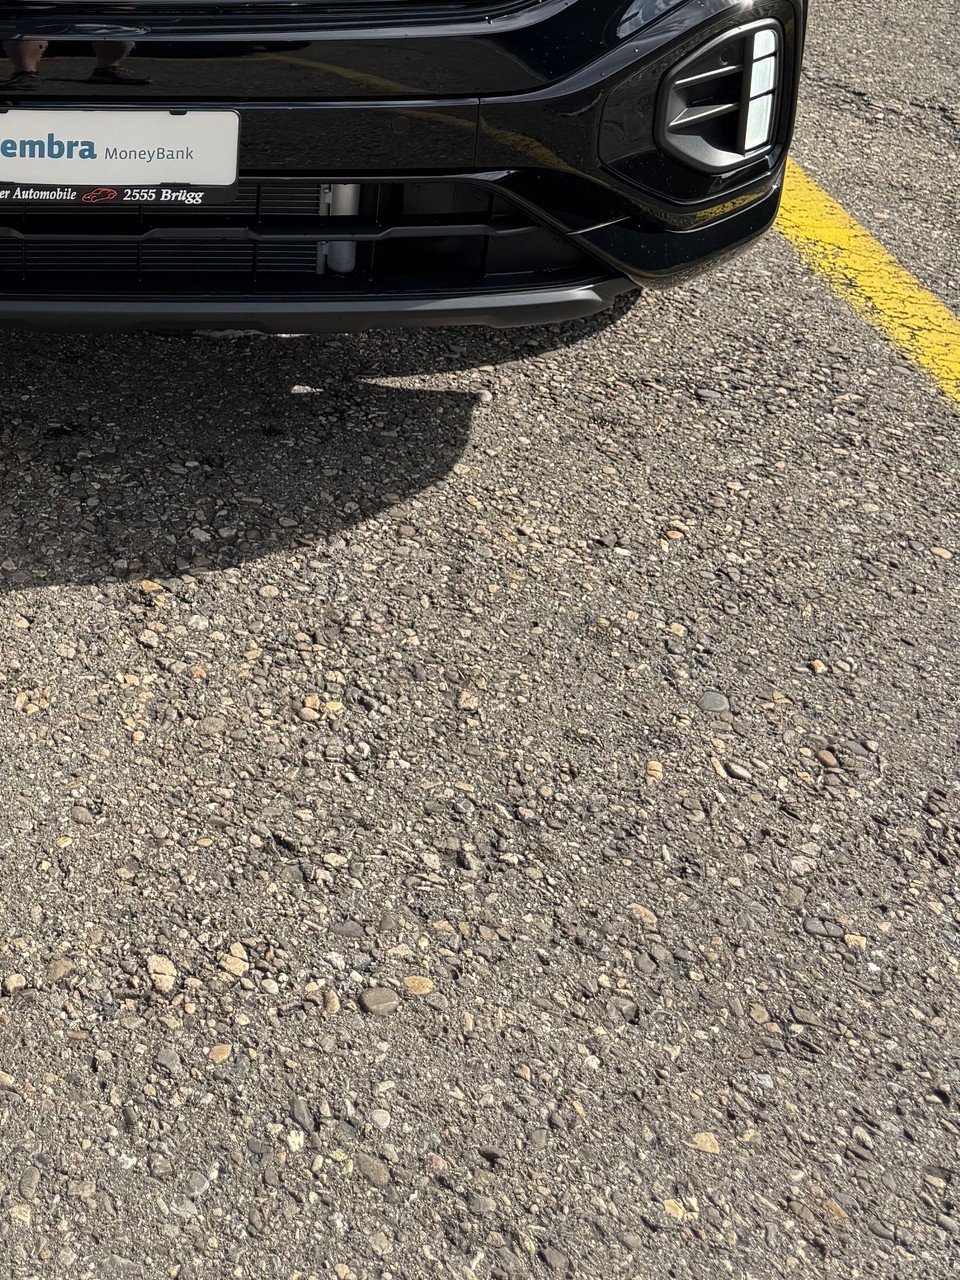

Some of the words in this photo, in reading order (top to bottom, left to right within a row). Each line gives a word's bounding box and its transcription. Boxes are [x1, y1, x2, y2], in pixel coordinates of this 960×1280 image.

[104, 147, 194, 162] MoneyBank
[12, 187, 77, 200] Automobile
[123, 189, 156, 201] 2555
[159, 189, 204, 204] Brügg
